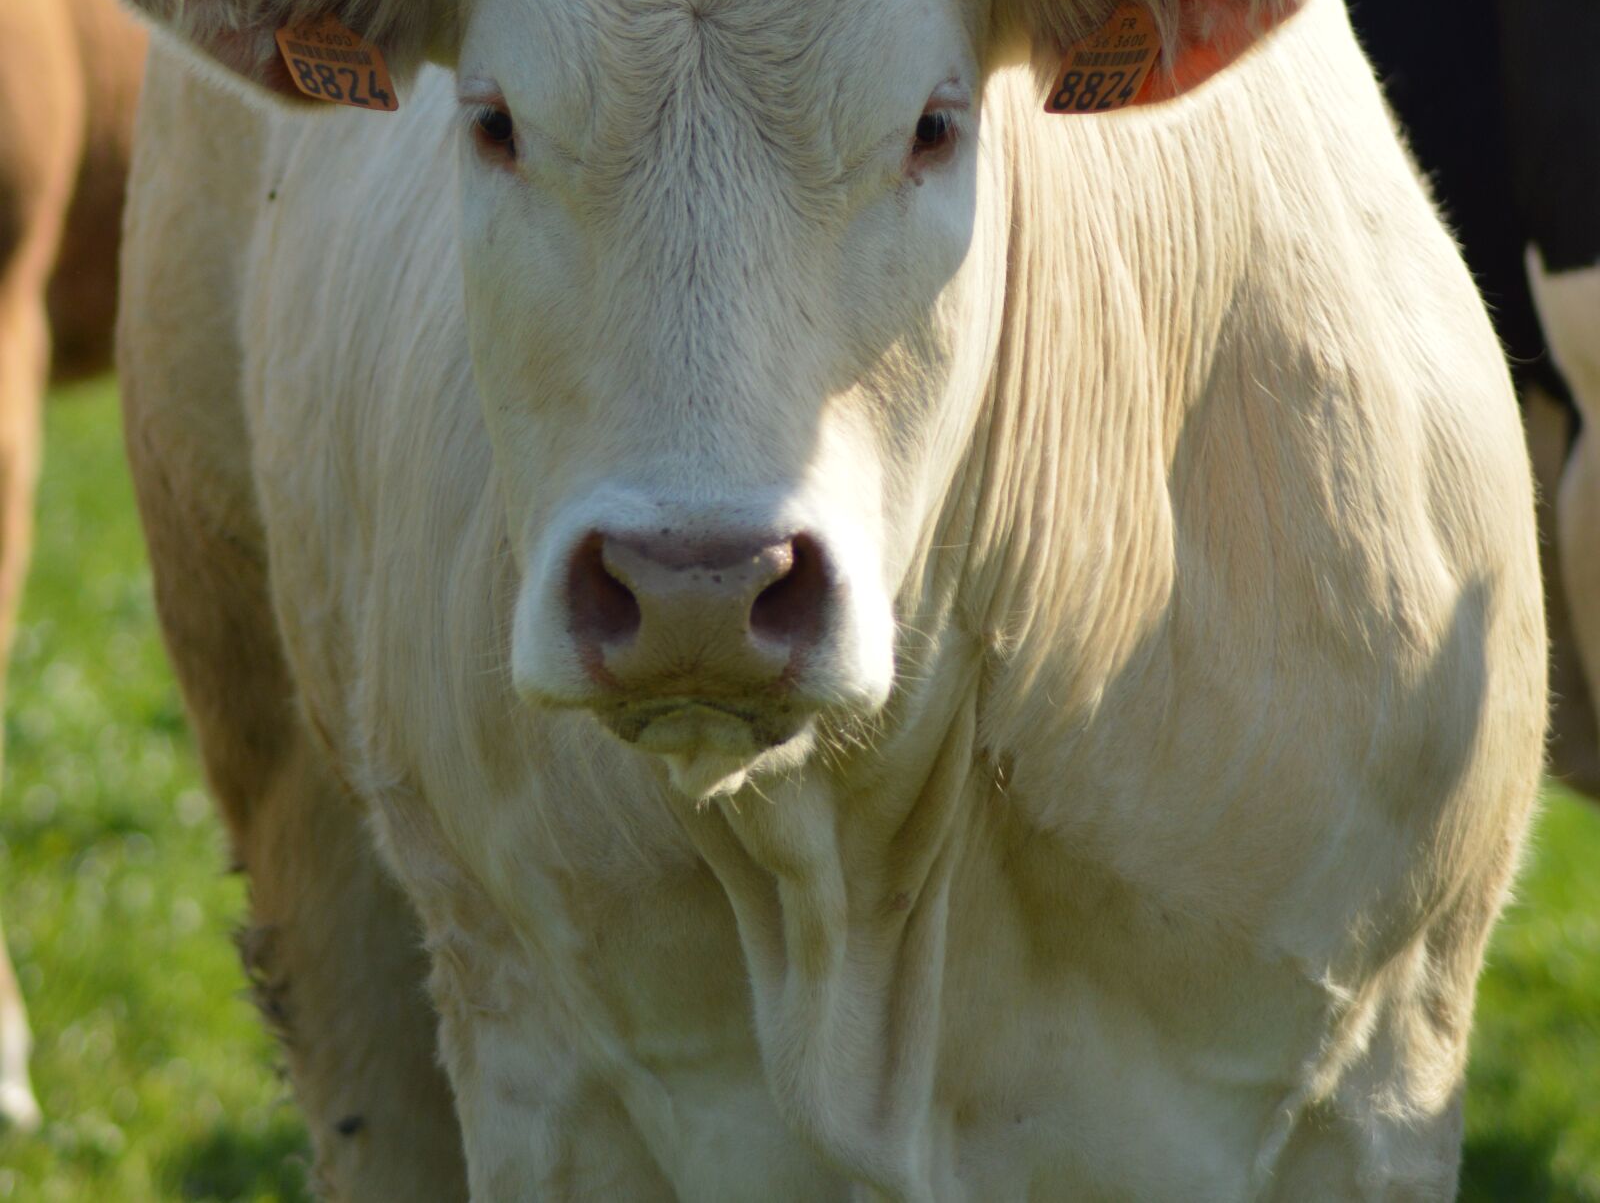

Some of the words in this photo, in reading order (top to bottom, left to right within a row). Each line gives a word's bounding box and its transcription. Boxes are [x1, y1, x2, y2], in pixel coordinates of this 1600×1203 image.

[1120, 17, 1136, 30] FR
[1113, 34, 1147, 48] 3600
[292, 58, 389, 107] 8824
[1053, 66, 1141, 110] 8824
